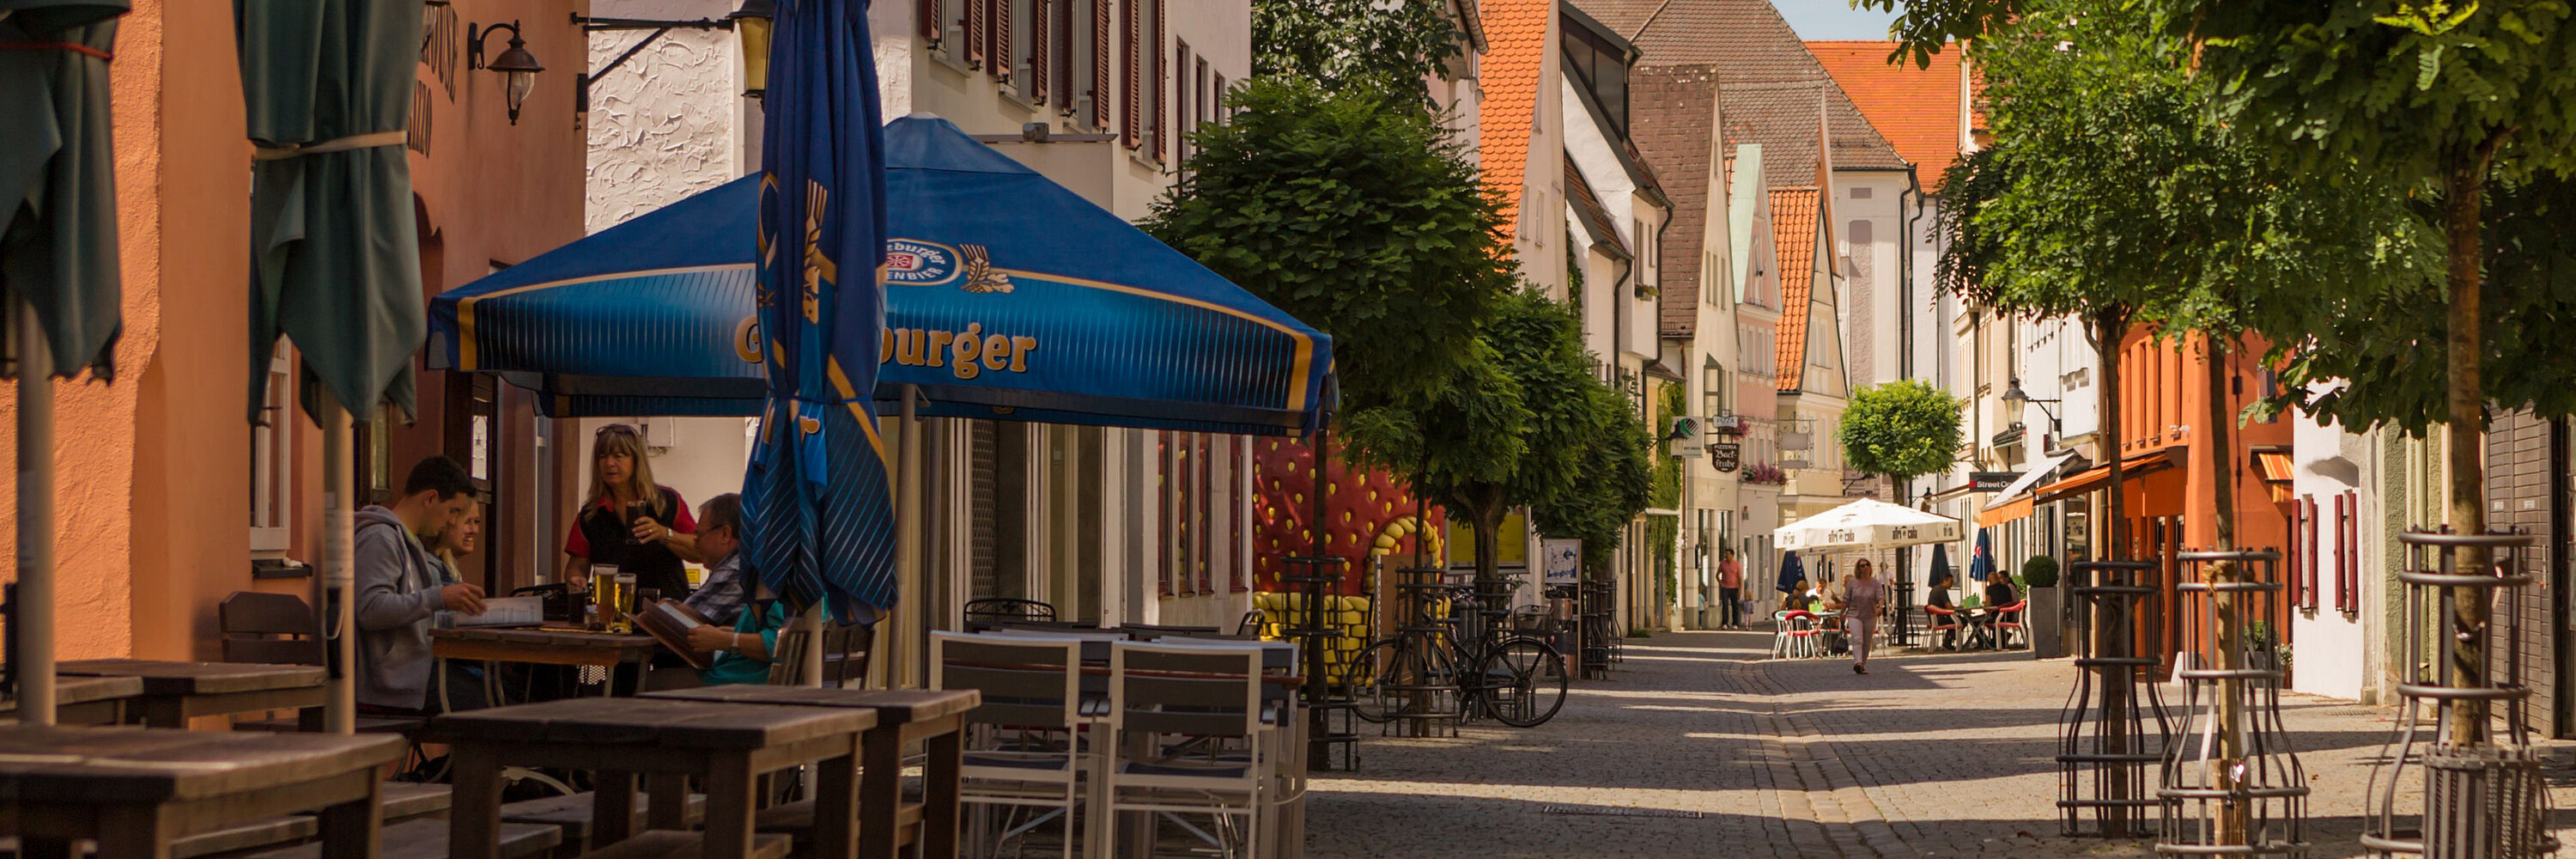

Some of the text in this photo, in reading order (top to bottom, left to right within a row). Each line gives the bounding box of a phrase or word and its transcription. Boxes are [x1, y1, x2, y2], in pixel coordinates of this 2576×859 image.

[422, 3, 458, 104] OUSE
[886, 267, 944, 280] ENBIER
[887, 241, 945, 265] zburger
[734, 316, 1036, 379] Gurger
